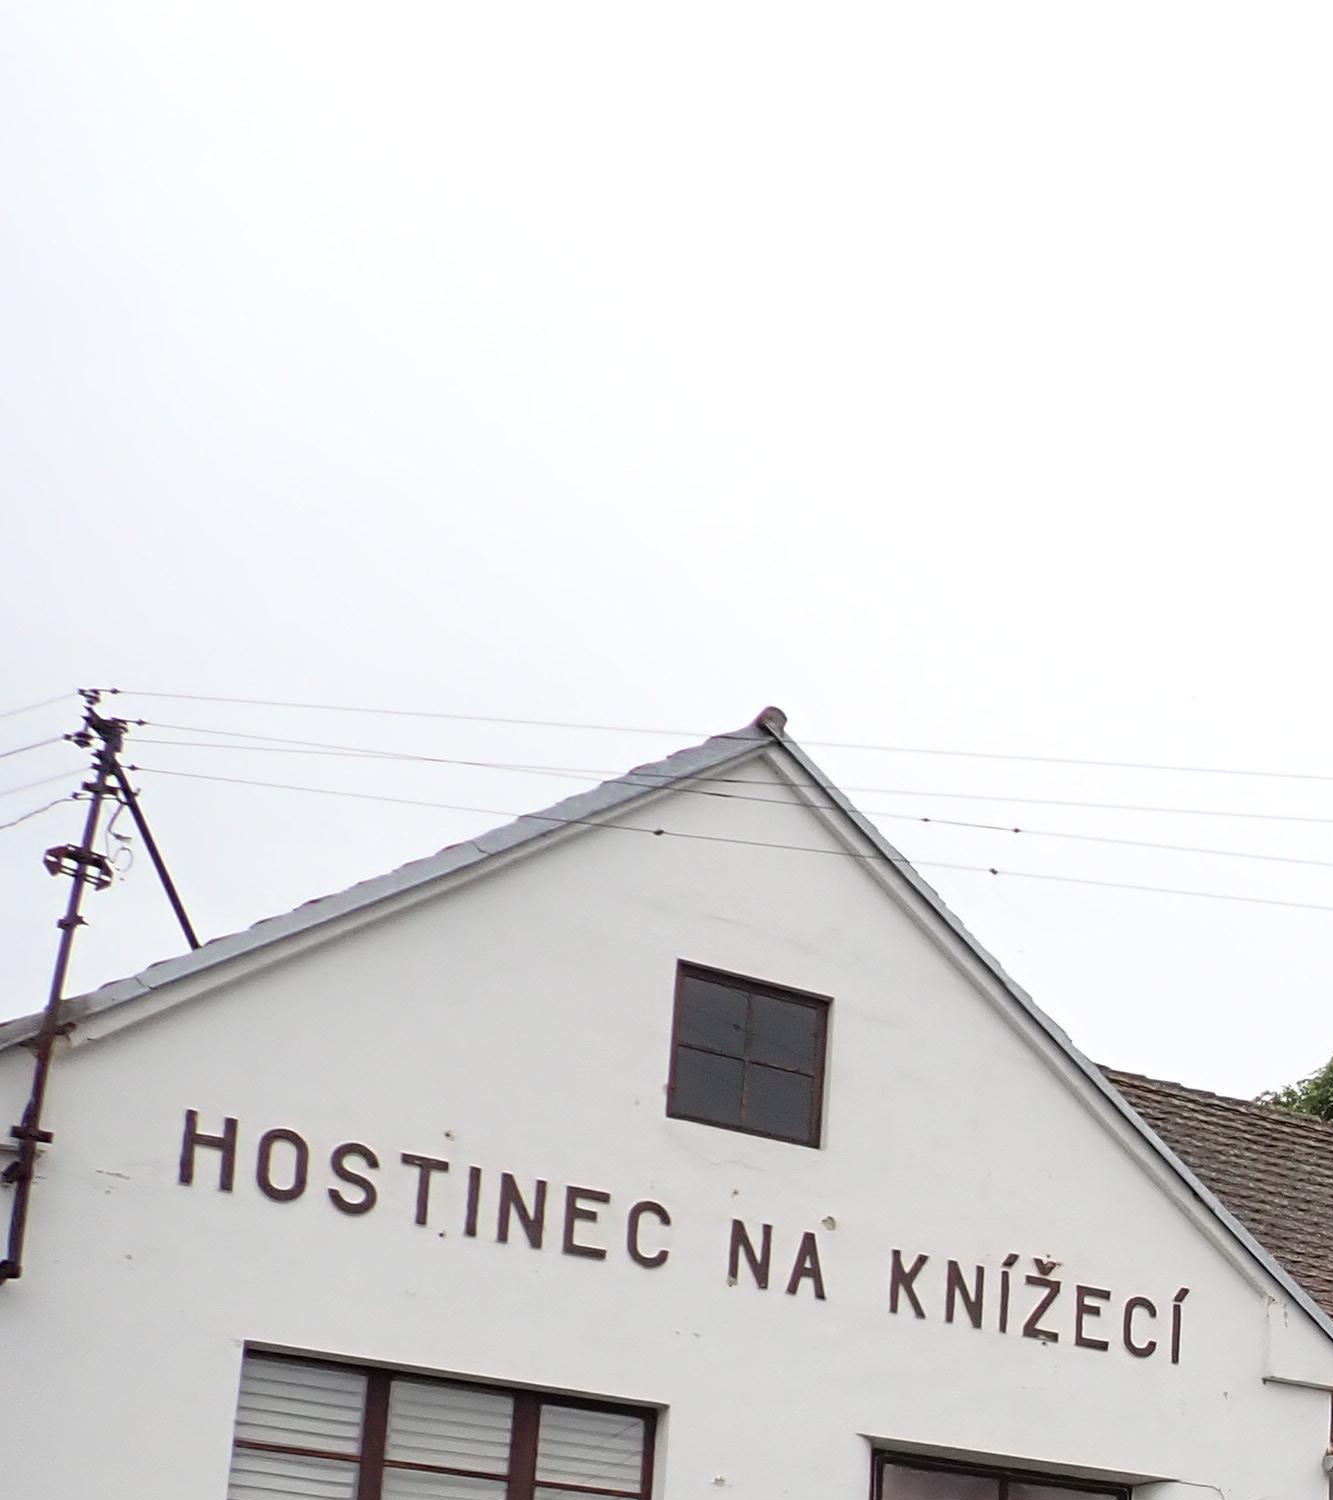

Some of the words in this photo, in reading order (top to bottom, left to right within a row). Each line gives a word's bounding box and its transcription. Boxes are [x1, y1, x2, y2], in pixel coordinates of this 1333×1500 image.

[179, 1109, 671, 1269] HOSTINEC
[726, 1218, 826, 1300] NA
[888, 1249, 1190, 1364] KNÍŽECÍ
